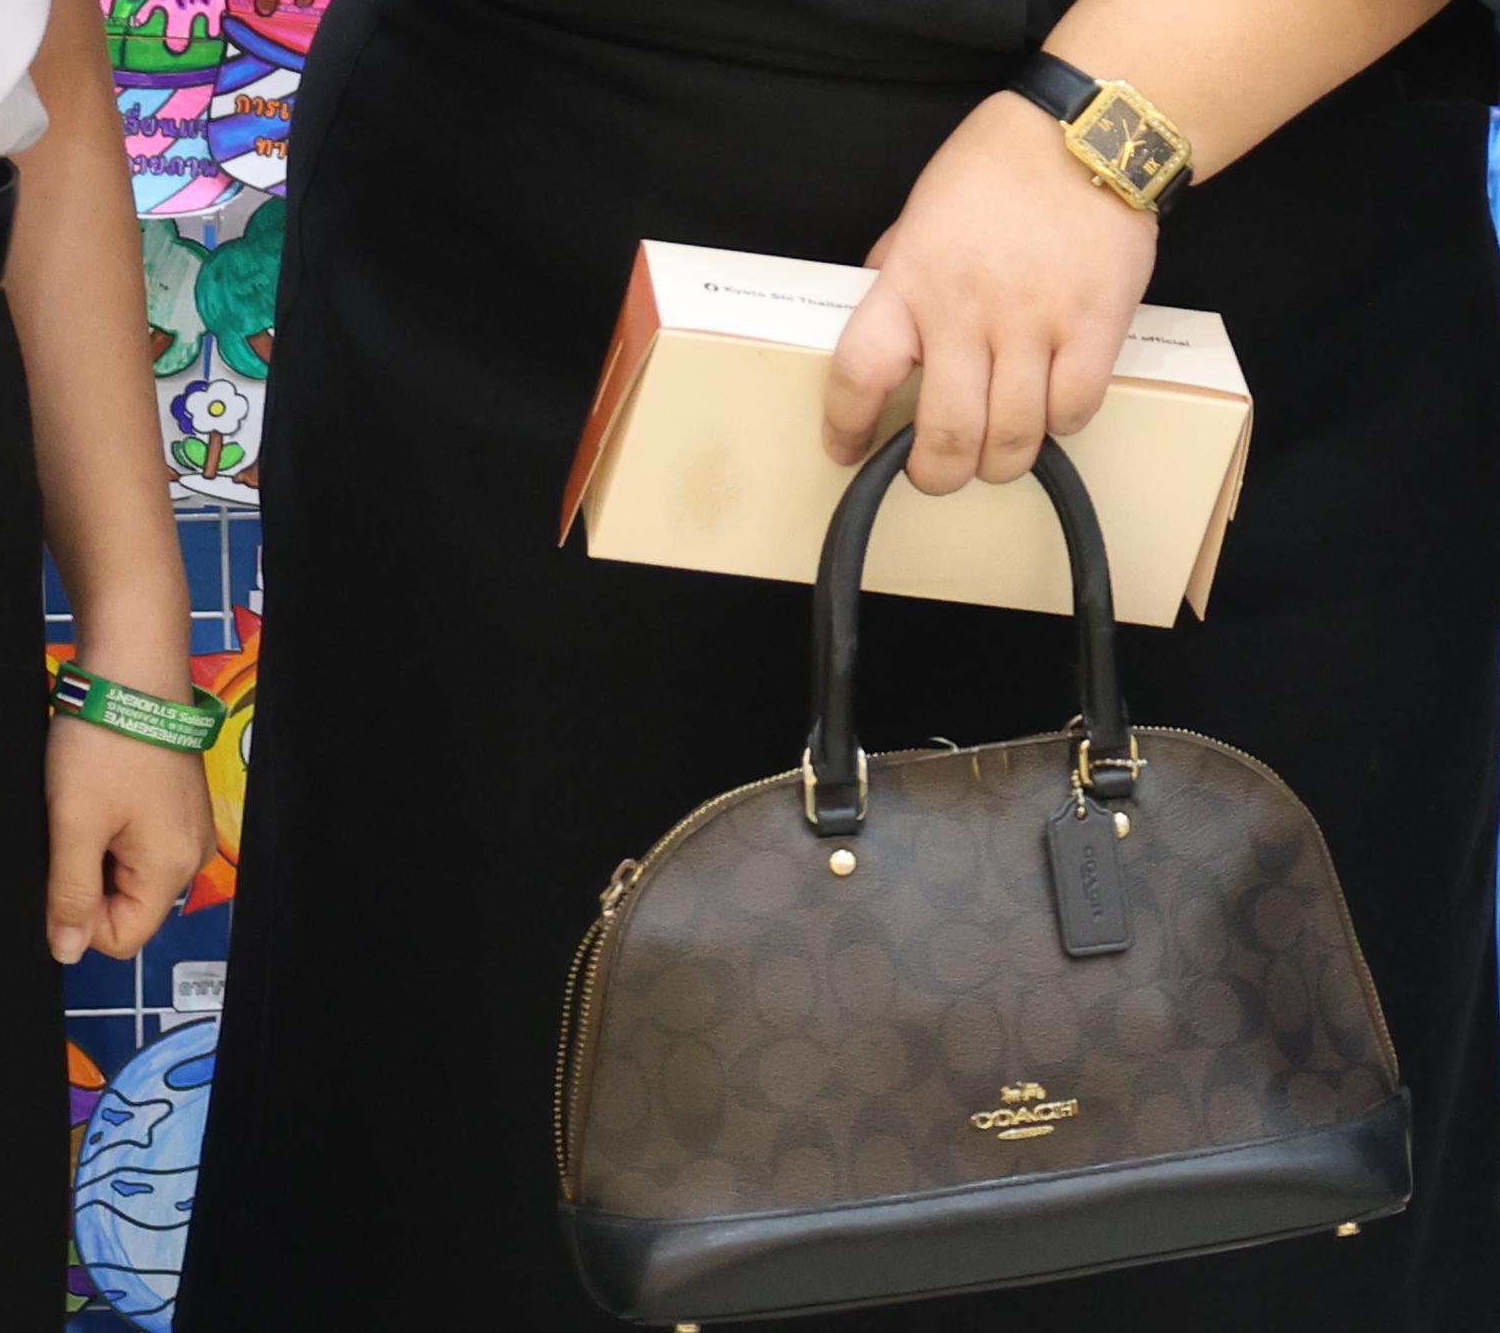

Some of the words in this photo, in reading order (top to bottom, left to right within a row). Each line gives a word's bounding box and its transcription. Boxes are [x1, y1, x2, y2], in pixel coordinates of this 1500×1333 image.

[769, 291, 795, 303] Shi
[105, 688, 177, 720] STUDENT
[102, 710, 176, 745] RESERVE
[176, 732, 203, 749] THAI
[1079, 844, 1103, 921] COACH
[970, 1098, 1079, 1131] COACH
